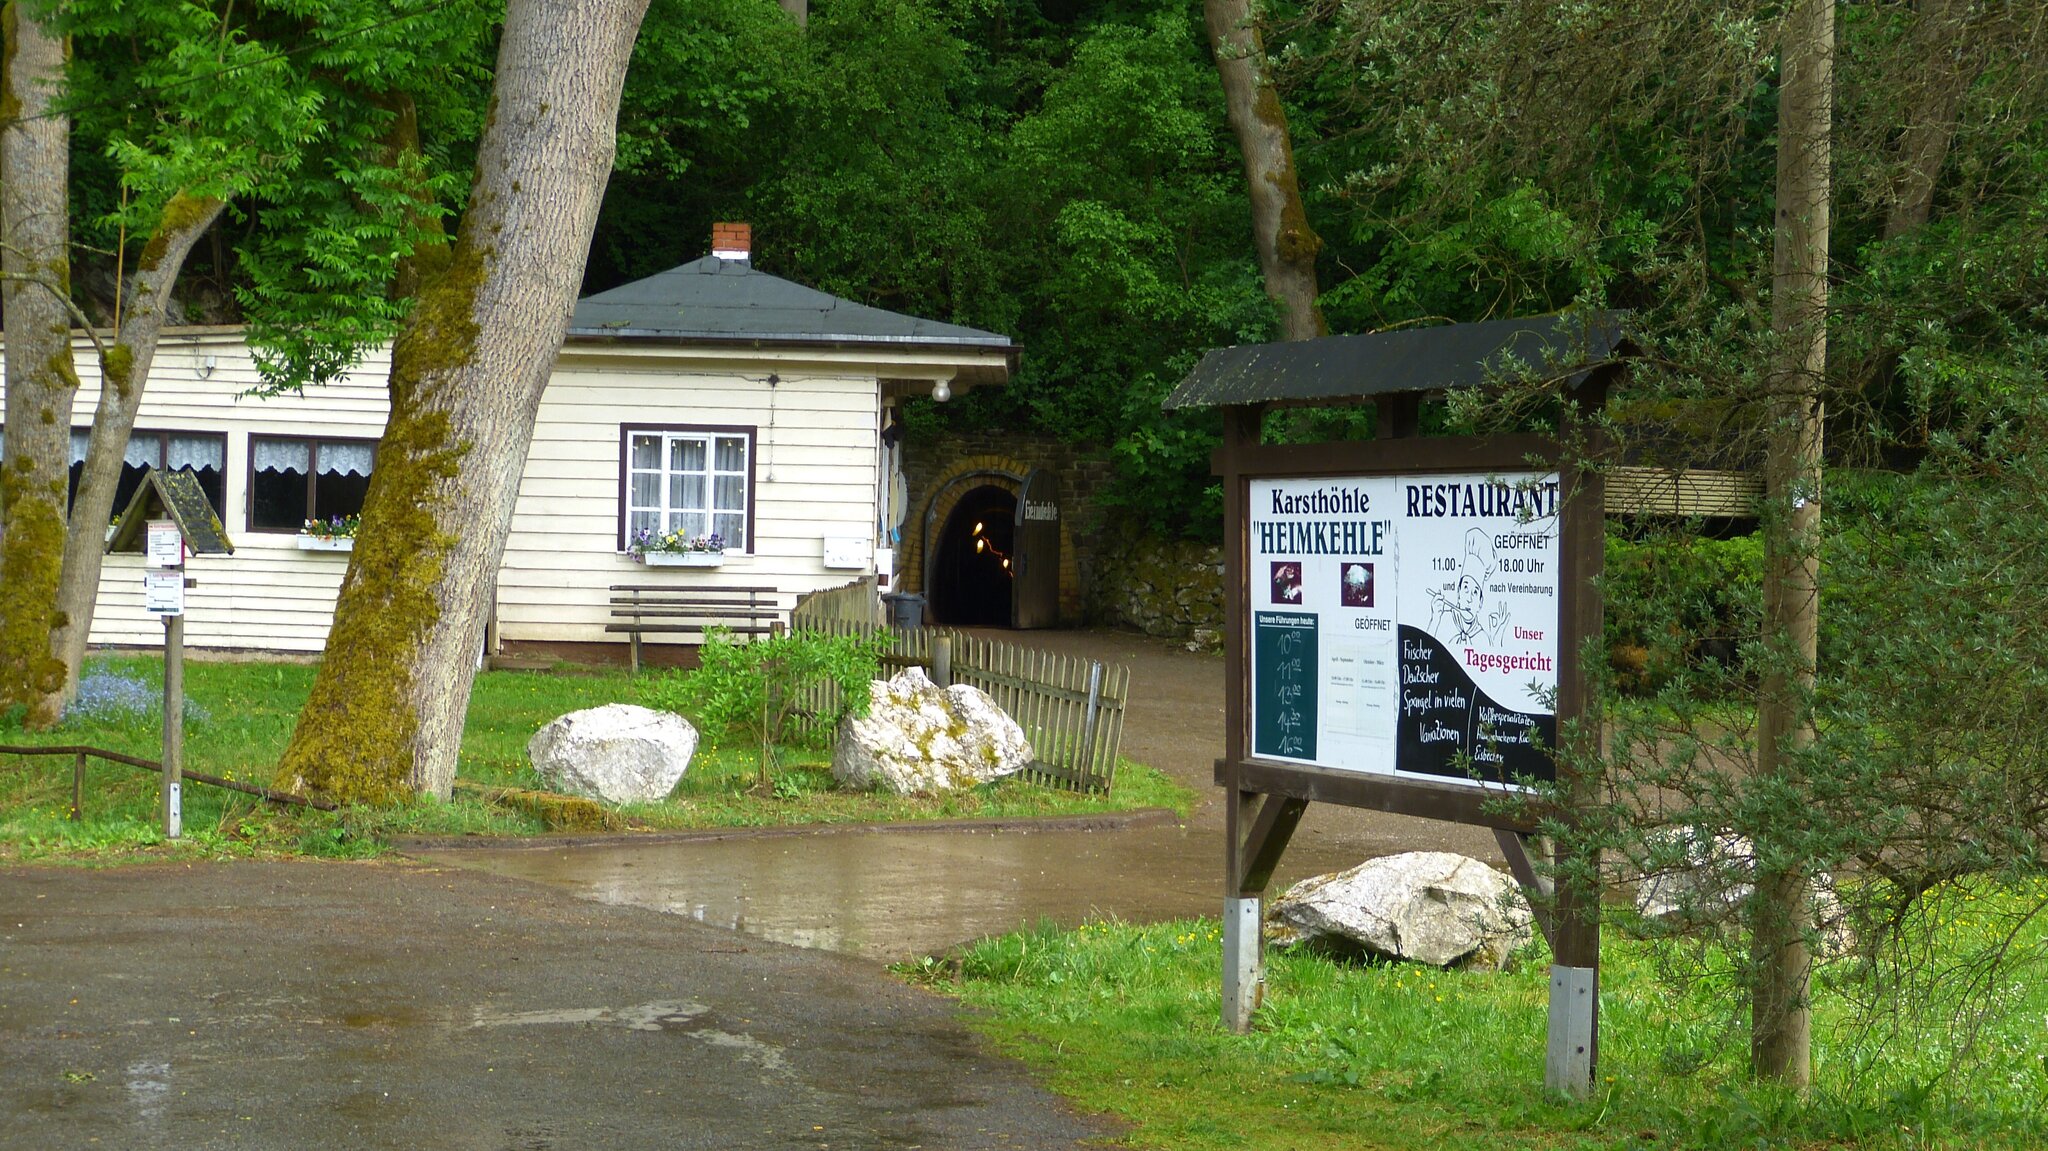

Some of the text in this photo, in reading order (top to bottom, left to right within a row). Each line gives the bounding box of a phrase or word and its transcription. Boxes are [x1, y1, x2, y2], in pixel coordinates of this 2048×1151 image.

[1272, 486, 1370, 515] Karsthöhle
[1406, 482, 1558, 517] RESTAURANT
[1253, 520, 1391, 556] "HEIMKEHLE"
[1494, 531, 1549, 550] GEÖFFNET
[1432, 557, 1456, 571] 11.00
[1498, 558, 1524, 573] 18.00
[1527, 558, 1545, 573] Uhr
[1442, 581, 1553, 597] und nach Vereinbarung
[1354, 616, 1391, 631] GEÖFFNET
[1514, 626, 1544, 641] Unser
[1463, 648, 1552, 675] Tagesgericht
[1403, 687, 1466, 717] Spargel in vielen
[1419, 719, 1460, 745] Variationen
